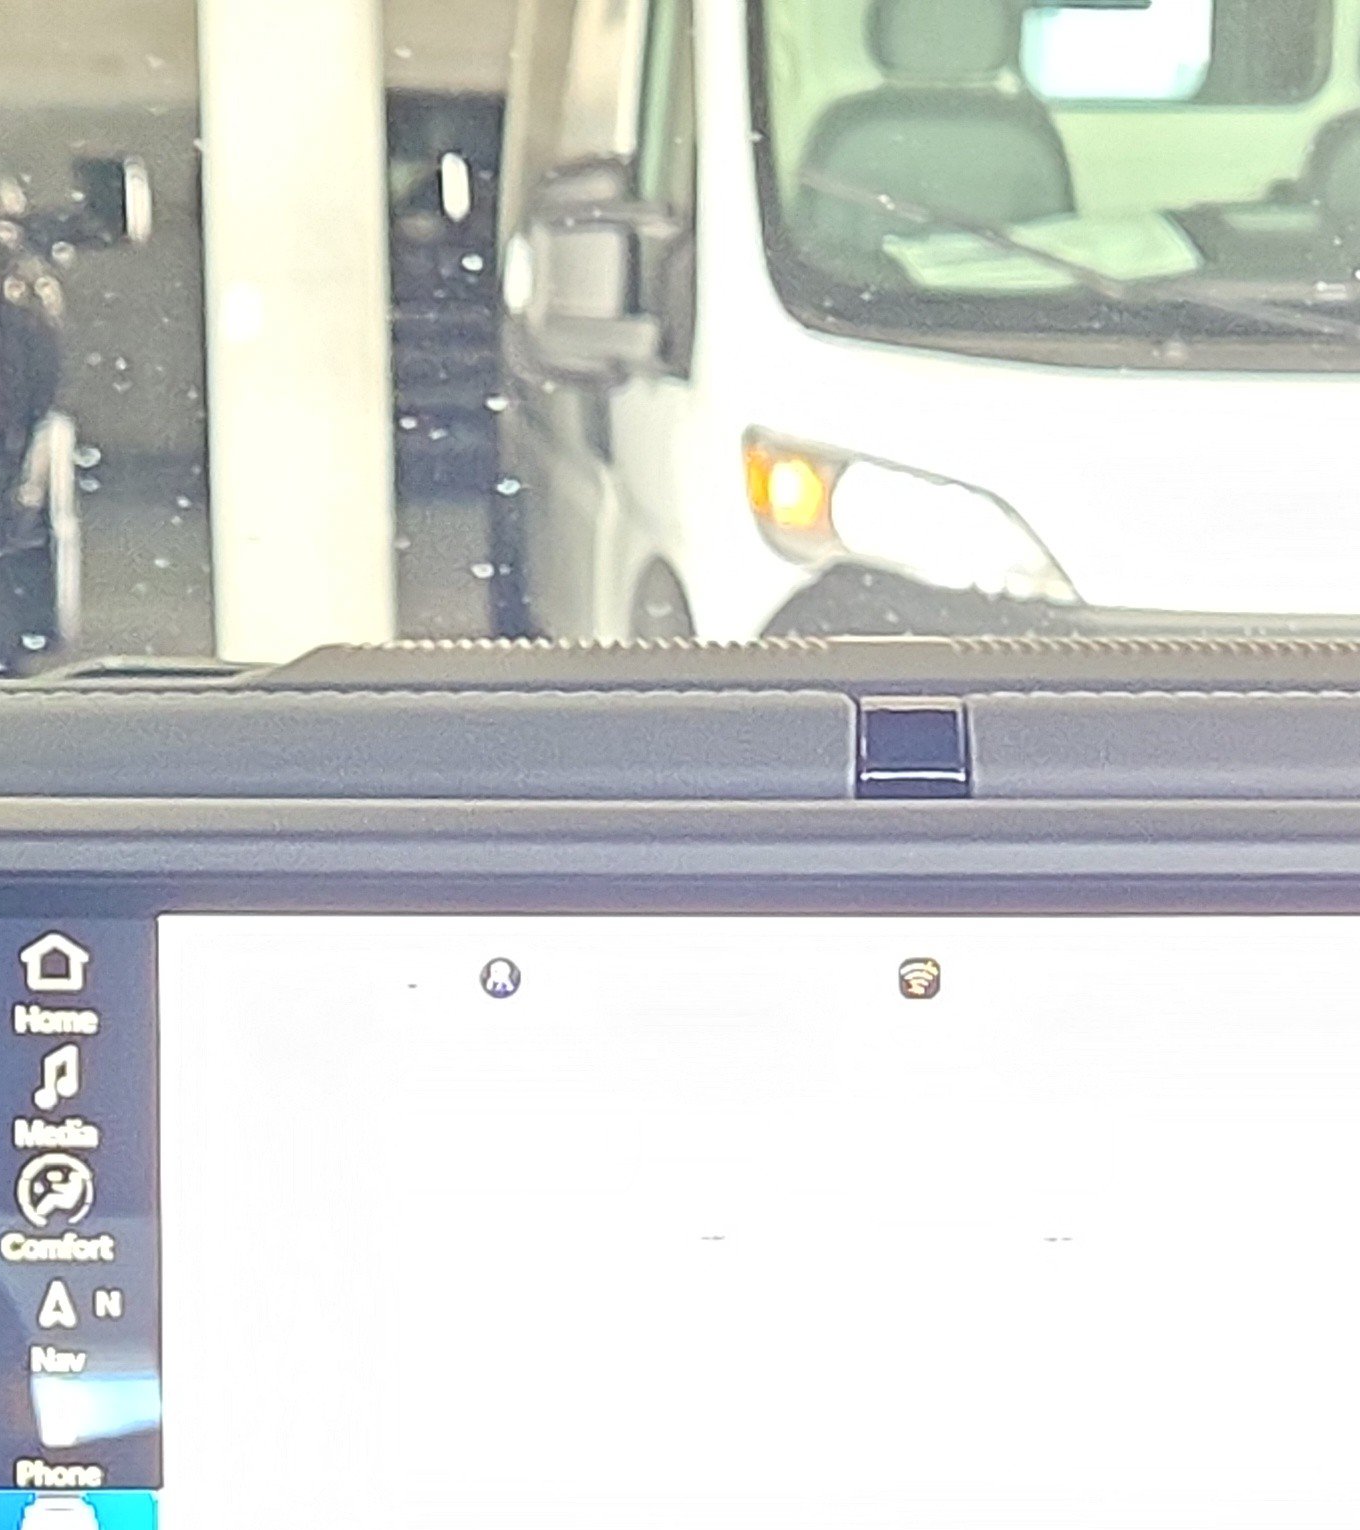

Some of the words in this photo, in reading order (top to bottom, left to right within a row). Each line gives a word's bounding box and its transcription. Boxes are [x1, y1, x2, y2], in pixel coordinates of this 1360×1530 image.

[15, 1005, 99, 1036] Home
[1, 1231, 115, 1264] Comfort
[95, 1291, 121, 1317] N
[31, 1346, 86, 1373] Nav
[16, 1460, 103, 1487] Phone
